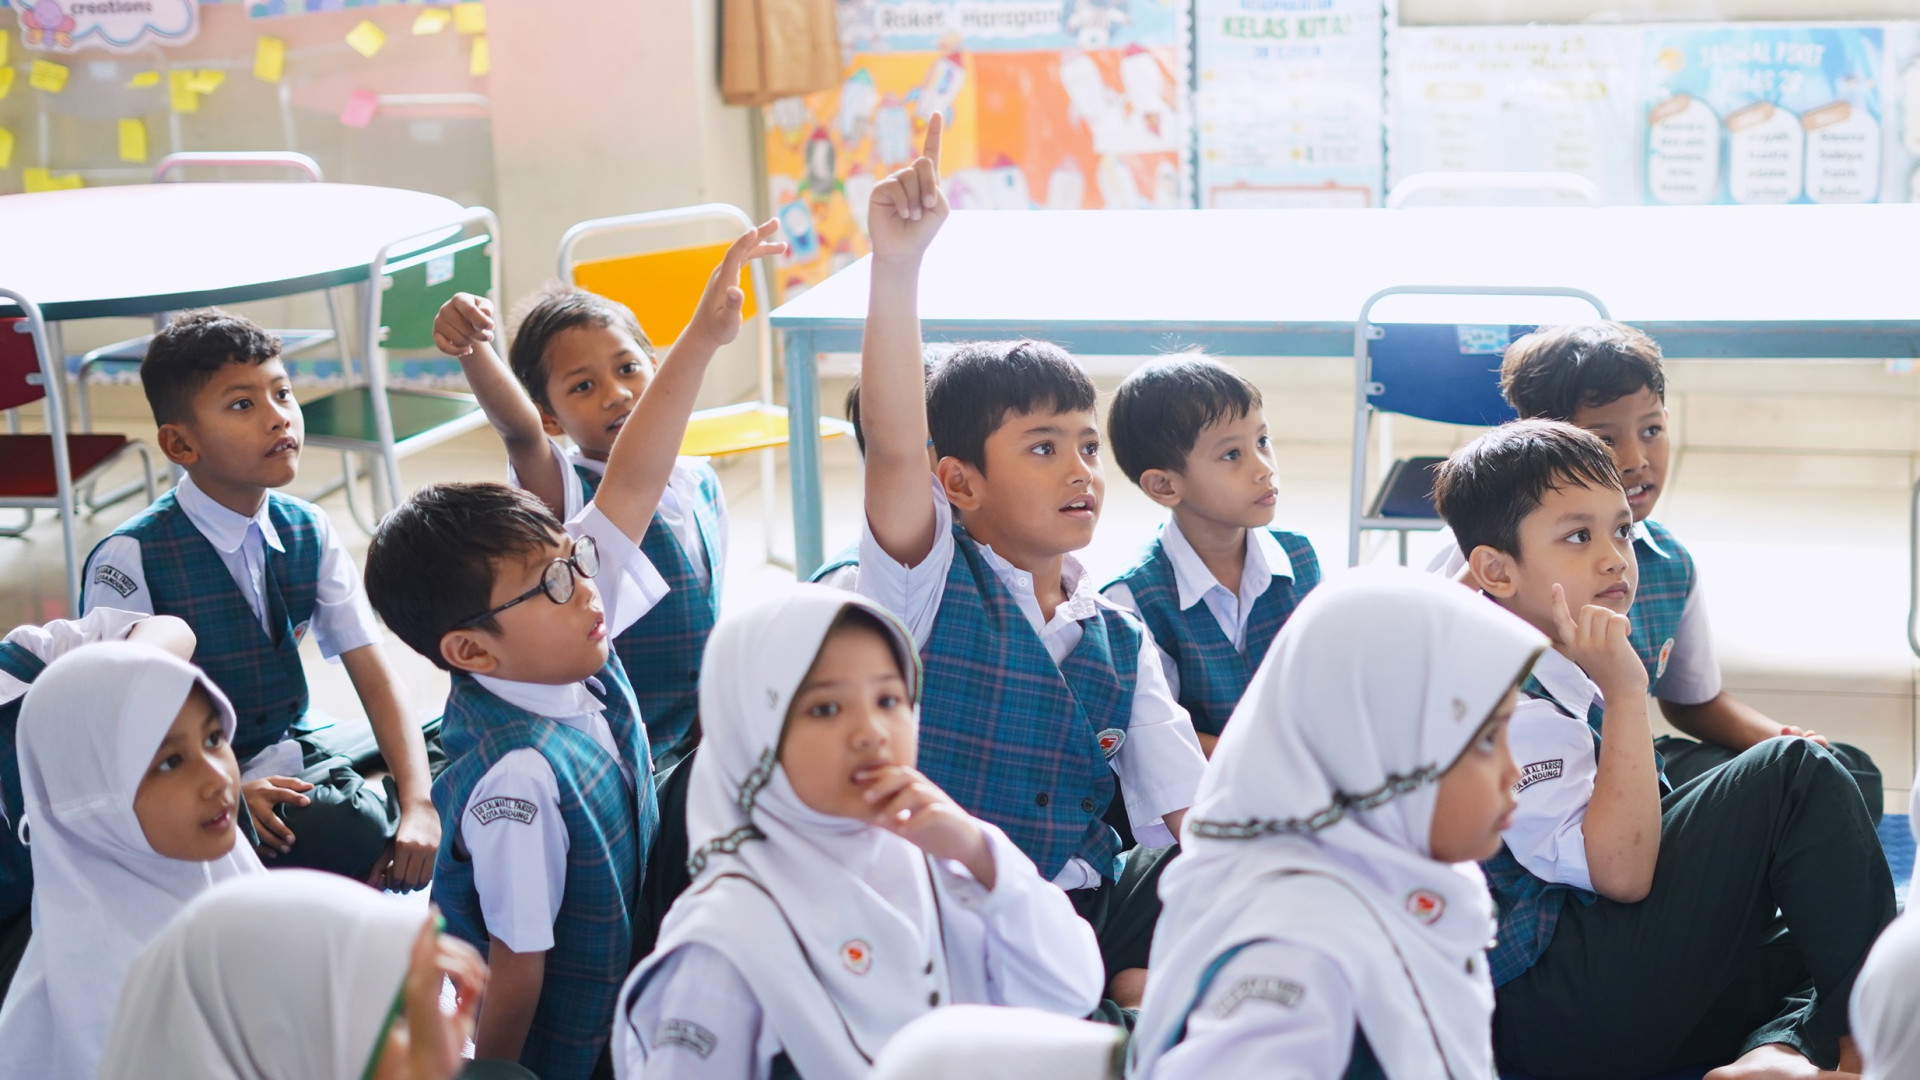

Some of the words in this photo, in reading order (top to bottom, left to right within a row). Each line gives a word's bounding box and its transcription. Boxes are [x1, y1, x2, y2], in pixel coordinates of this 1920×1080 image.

[70, 1, 153, 15] creations
[1223, 15, 1289, 39] KELAS
[1531, 765, 1541, 773] AL
[1541, 762, 1560, 771] FARISI
[1522, 770, 1558, 785] BANDUNG
[514, 802, 535, 814] FARISI
[481, 810, 498, 821] KOTA
